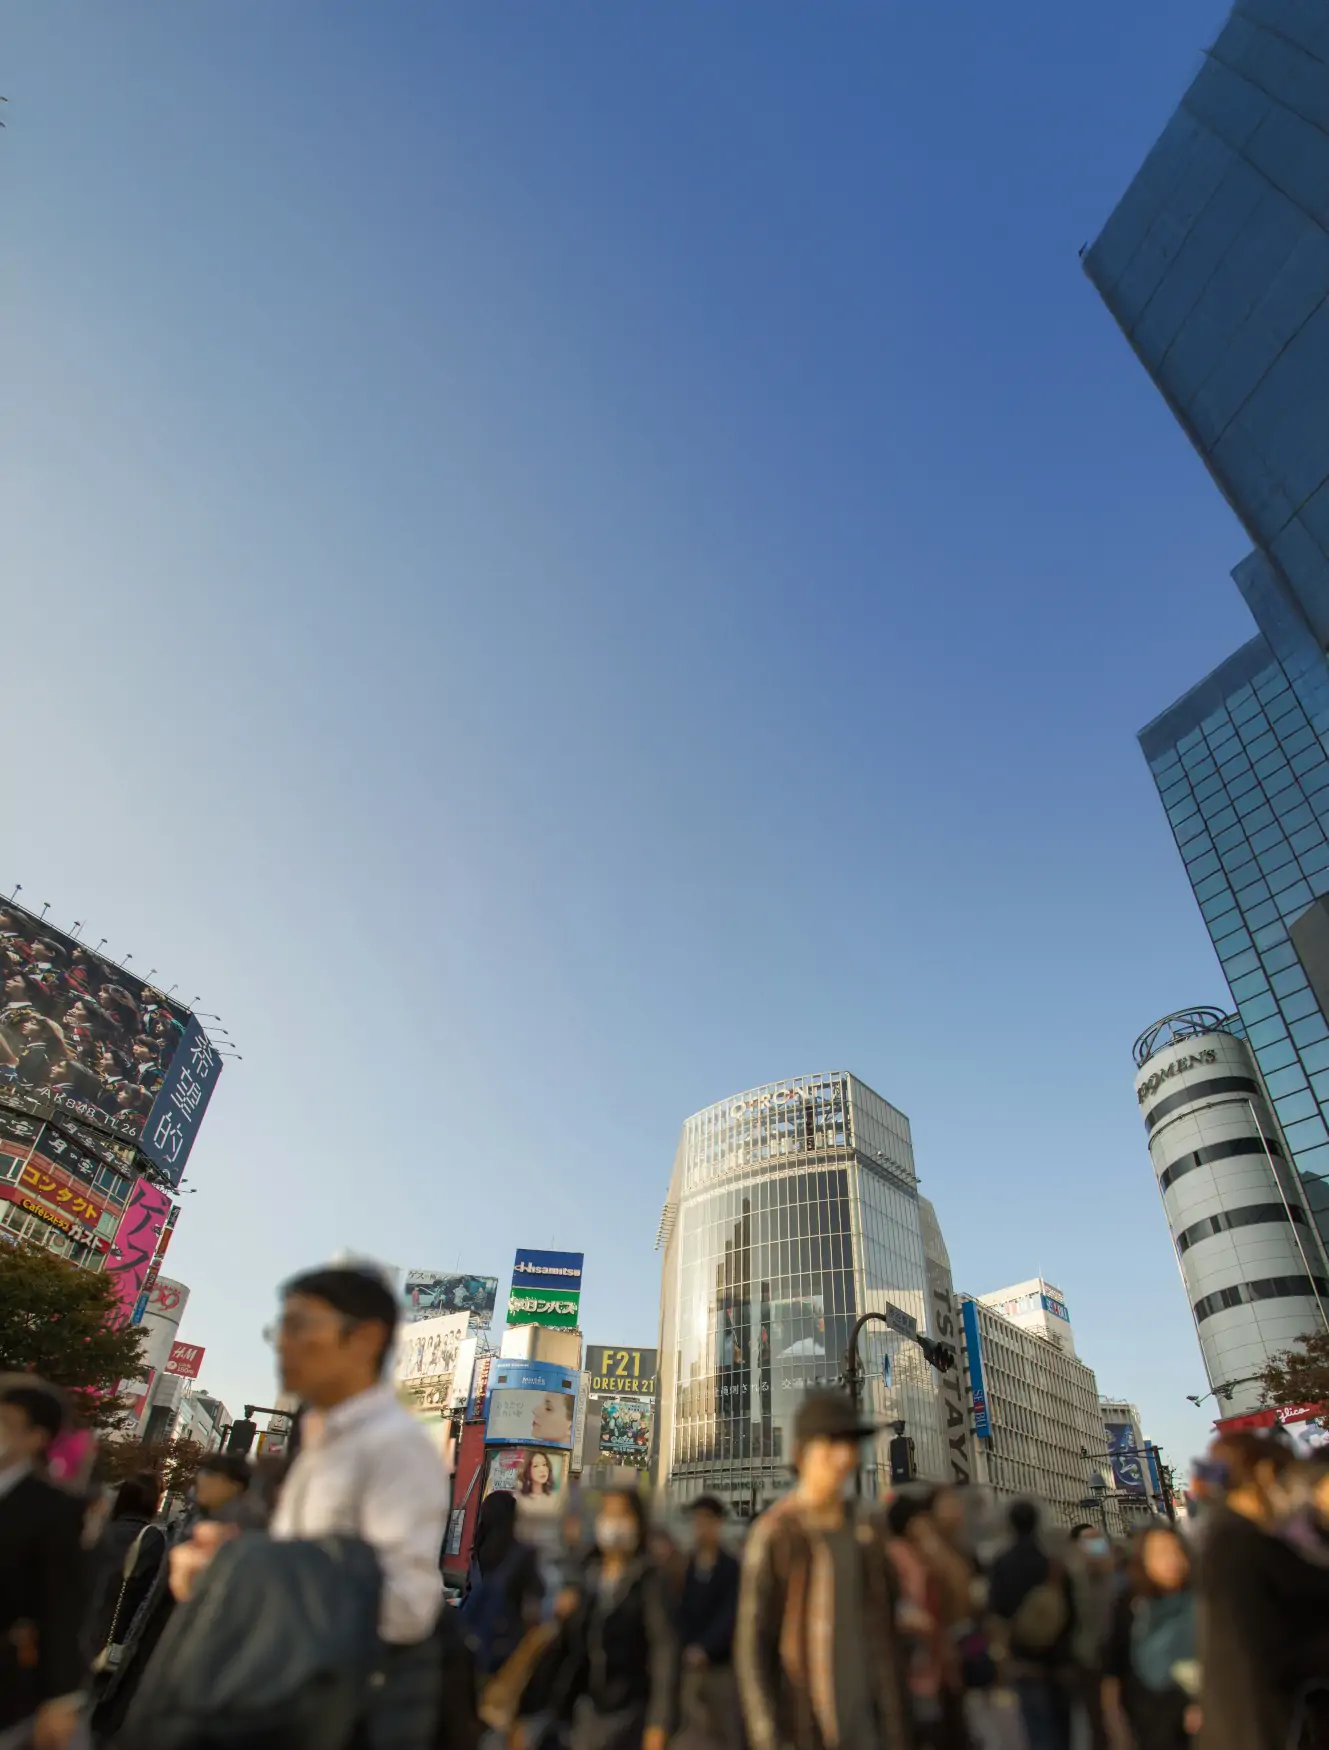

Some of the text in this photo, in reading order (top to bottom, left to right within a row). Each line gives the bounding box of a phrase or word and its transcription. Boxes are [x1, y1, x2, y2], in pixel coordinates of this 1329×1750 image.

[22, 1165, 98, 1219] コンタクト
[67, 1224, 103, 1250] ガスト
[514, 1261, 581, 1277] Hisamitsu
[173, 1346, 198, 1361] H&M
[601, 1350, 641, 1377] F21
[592, 1376, 655, 1393] OREVER 21
